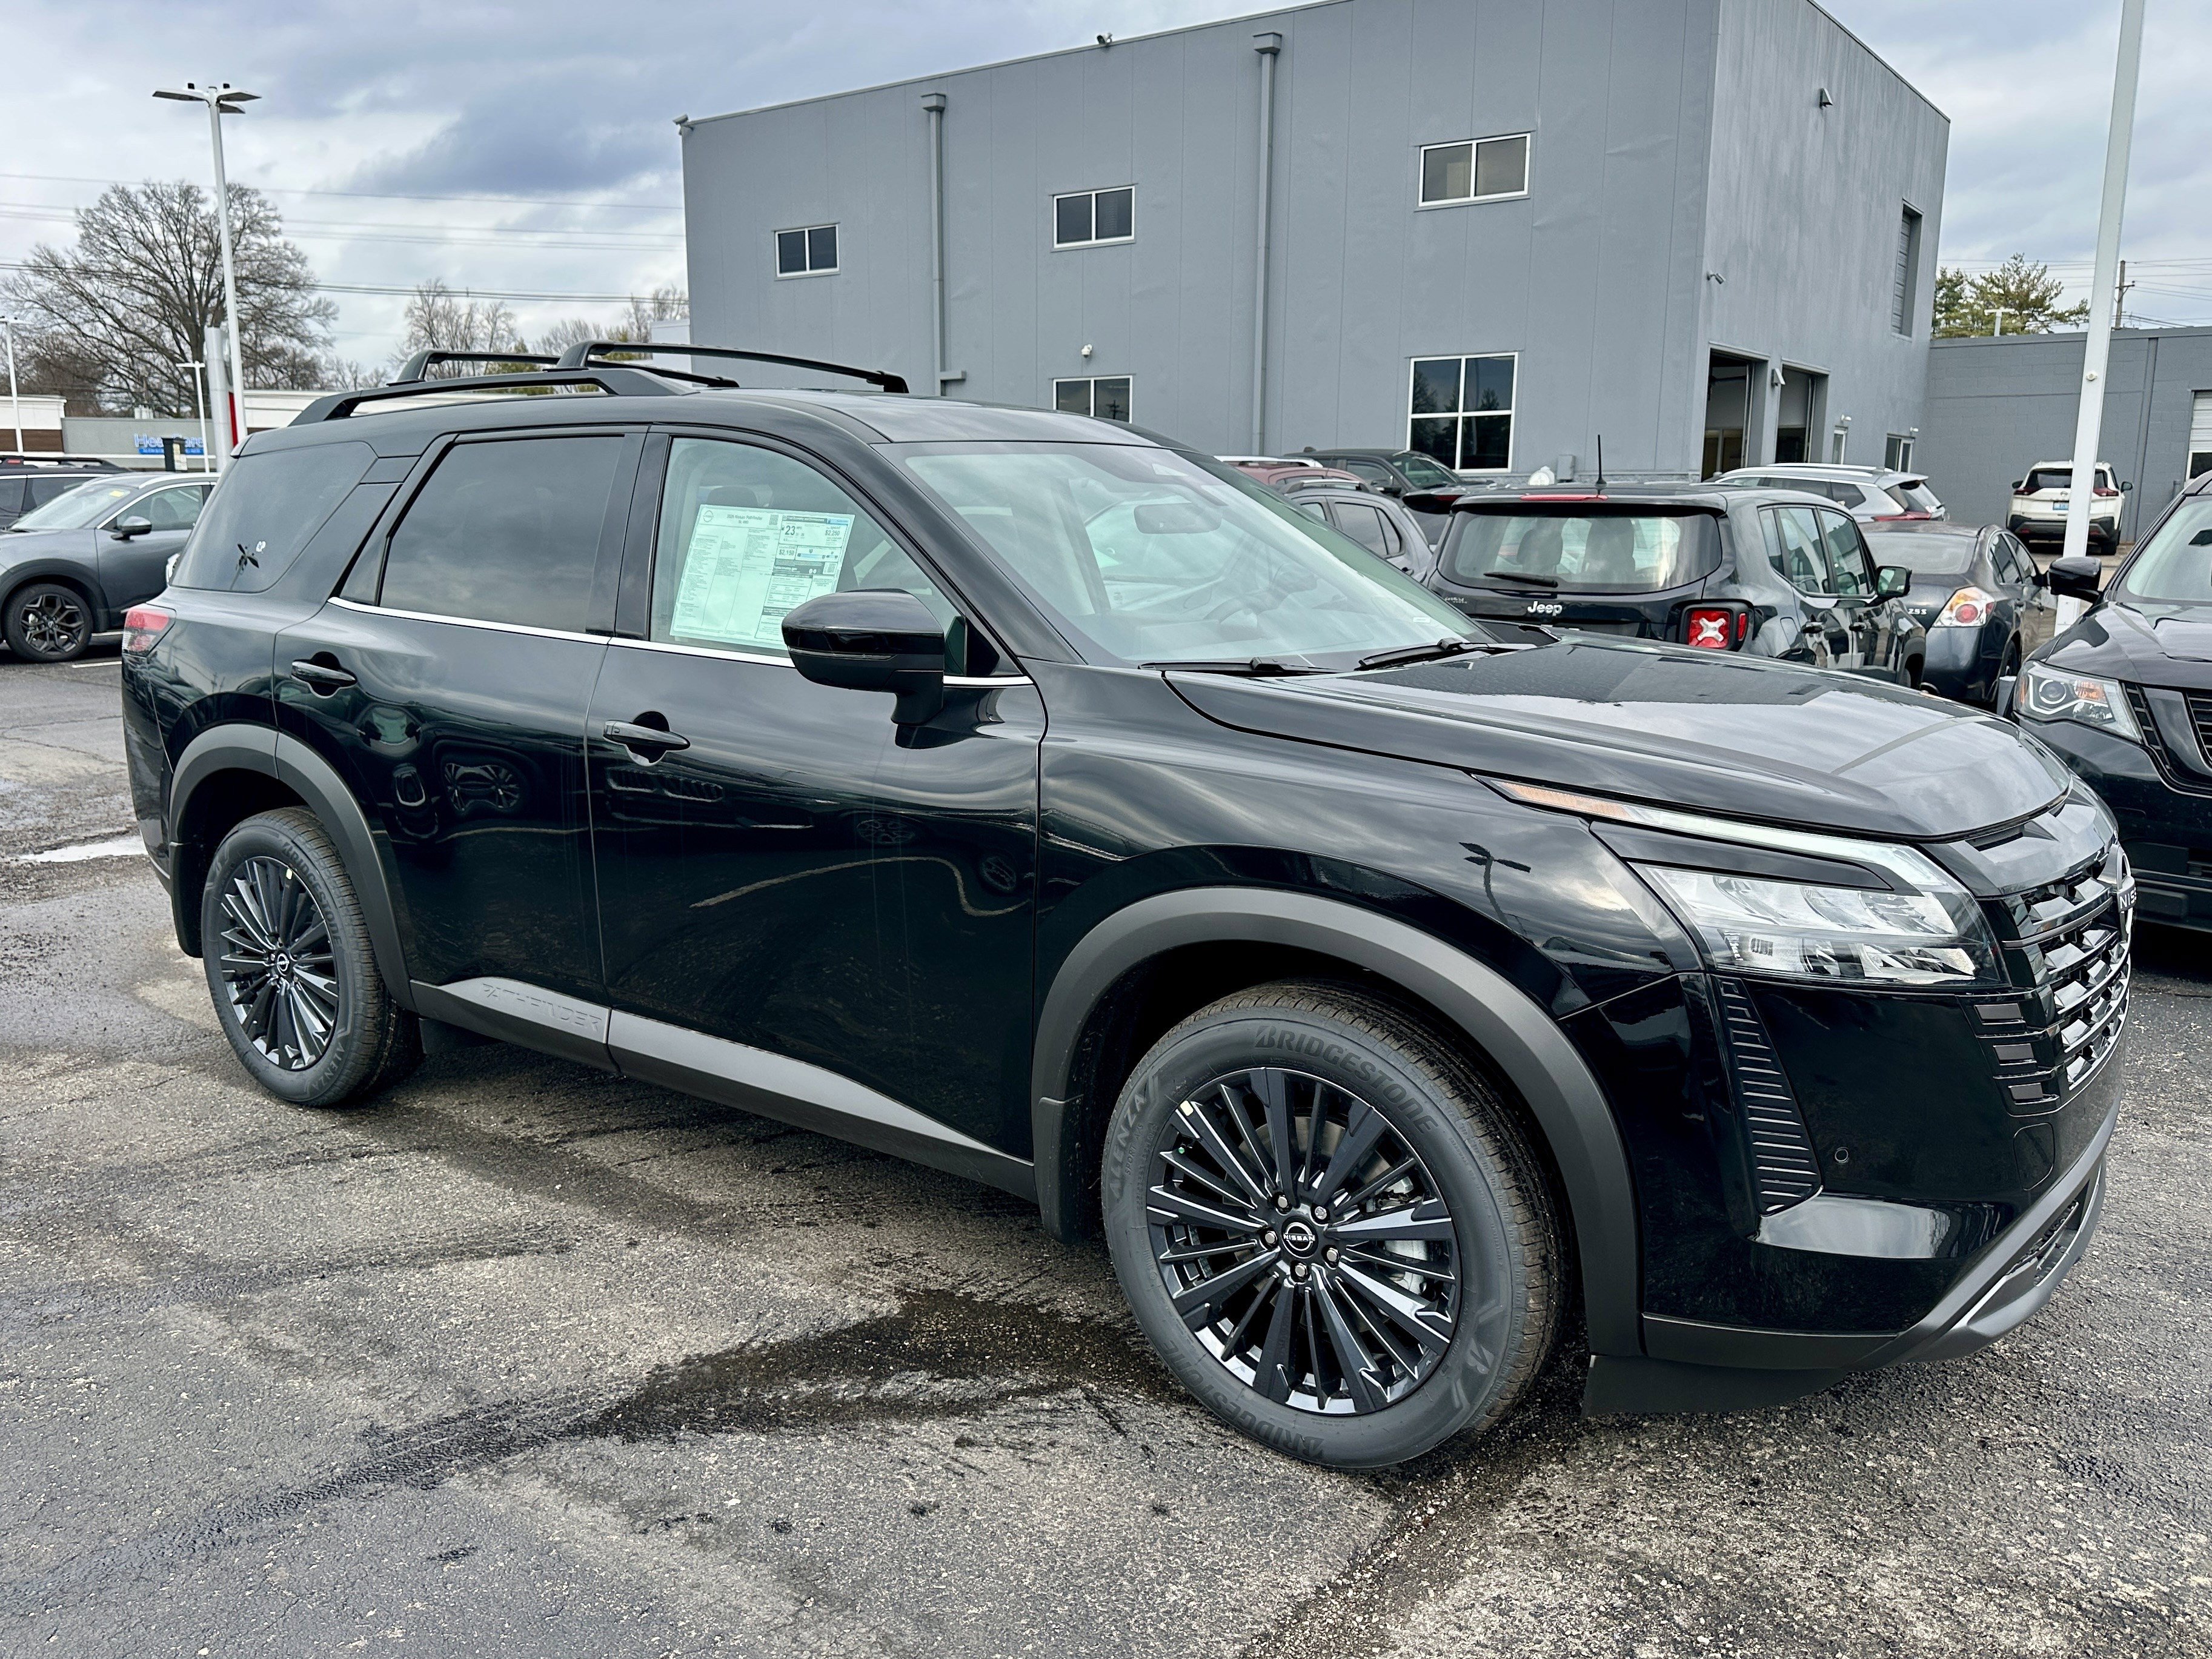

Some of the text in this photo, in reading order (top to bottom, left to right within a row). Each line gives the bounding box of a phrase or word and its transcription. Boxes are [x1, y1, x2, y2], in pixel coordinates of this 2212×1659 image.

[785, 525, 796, 536] 23
[1527, 600, 1563, 616] Jeep
[1255, 1025, 1440, 1134] BRIDGESTONE
[1109, 1092, 1146, 1203] ALENZA
[1283, 1233, 1315, 1242] NISSAN
